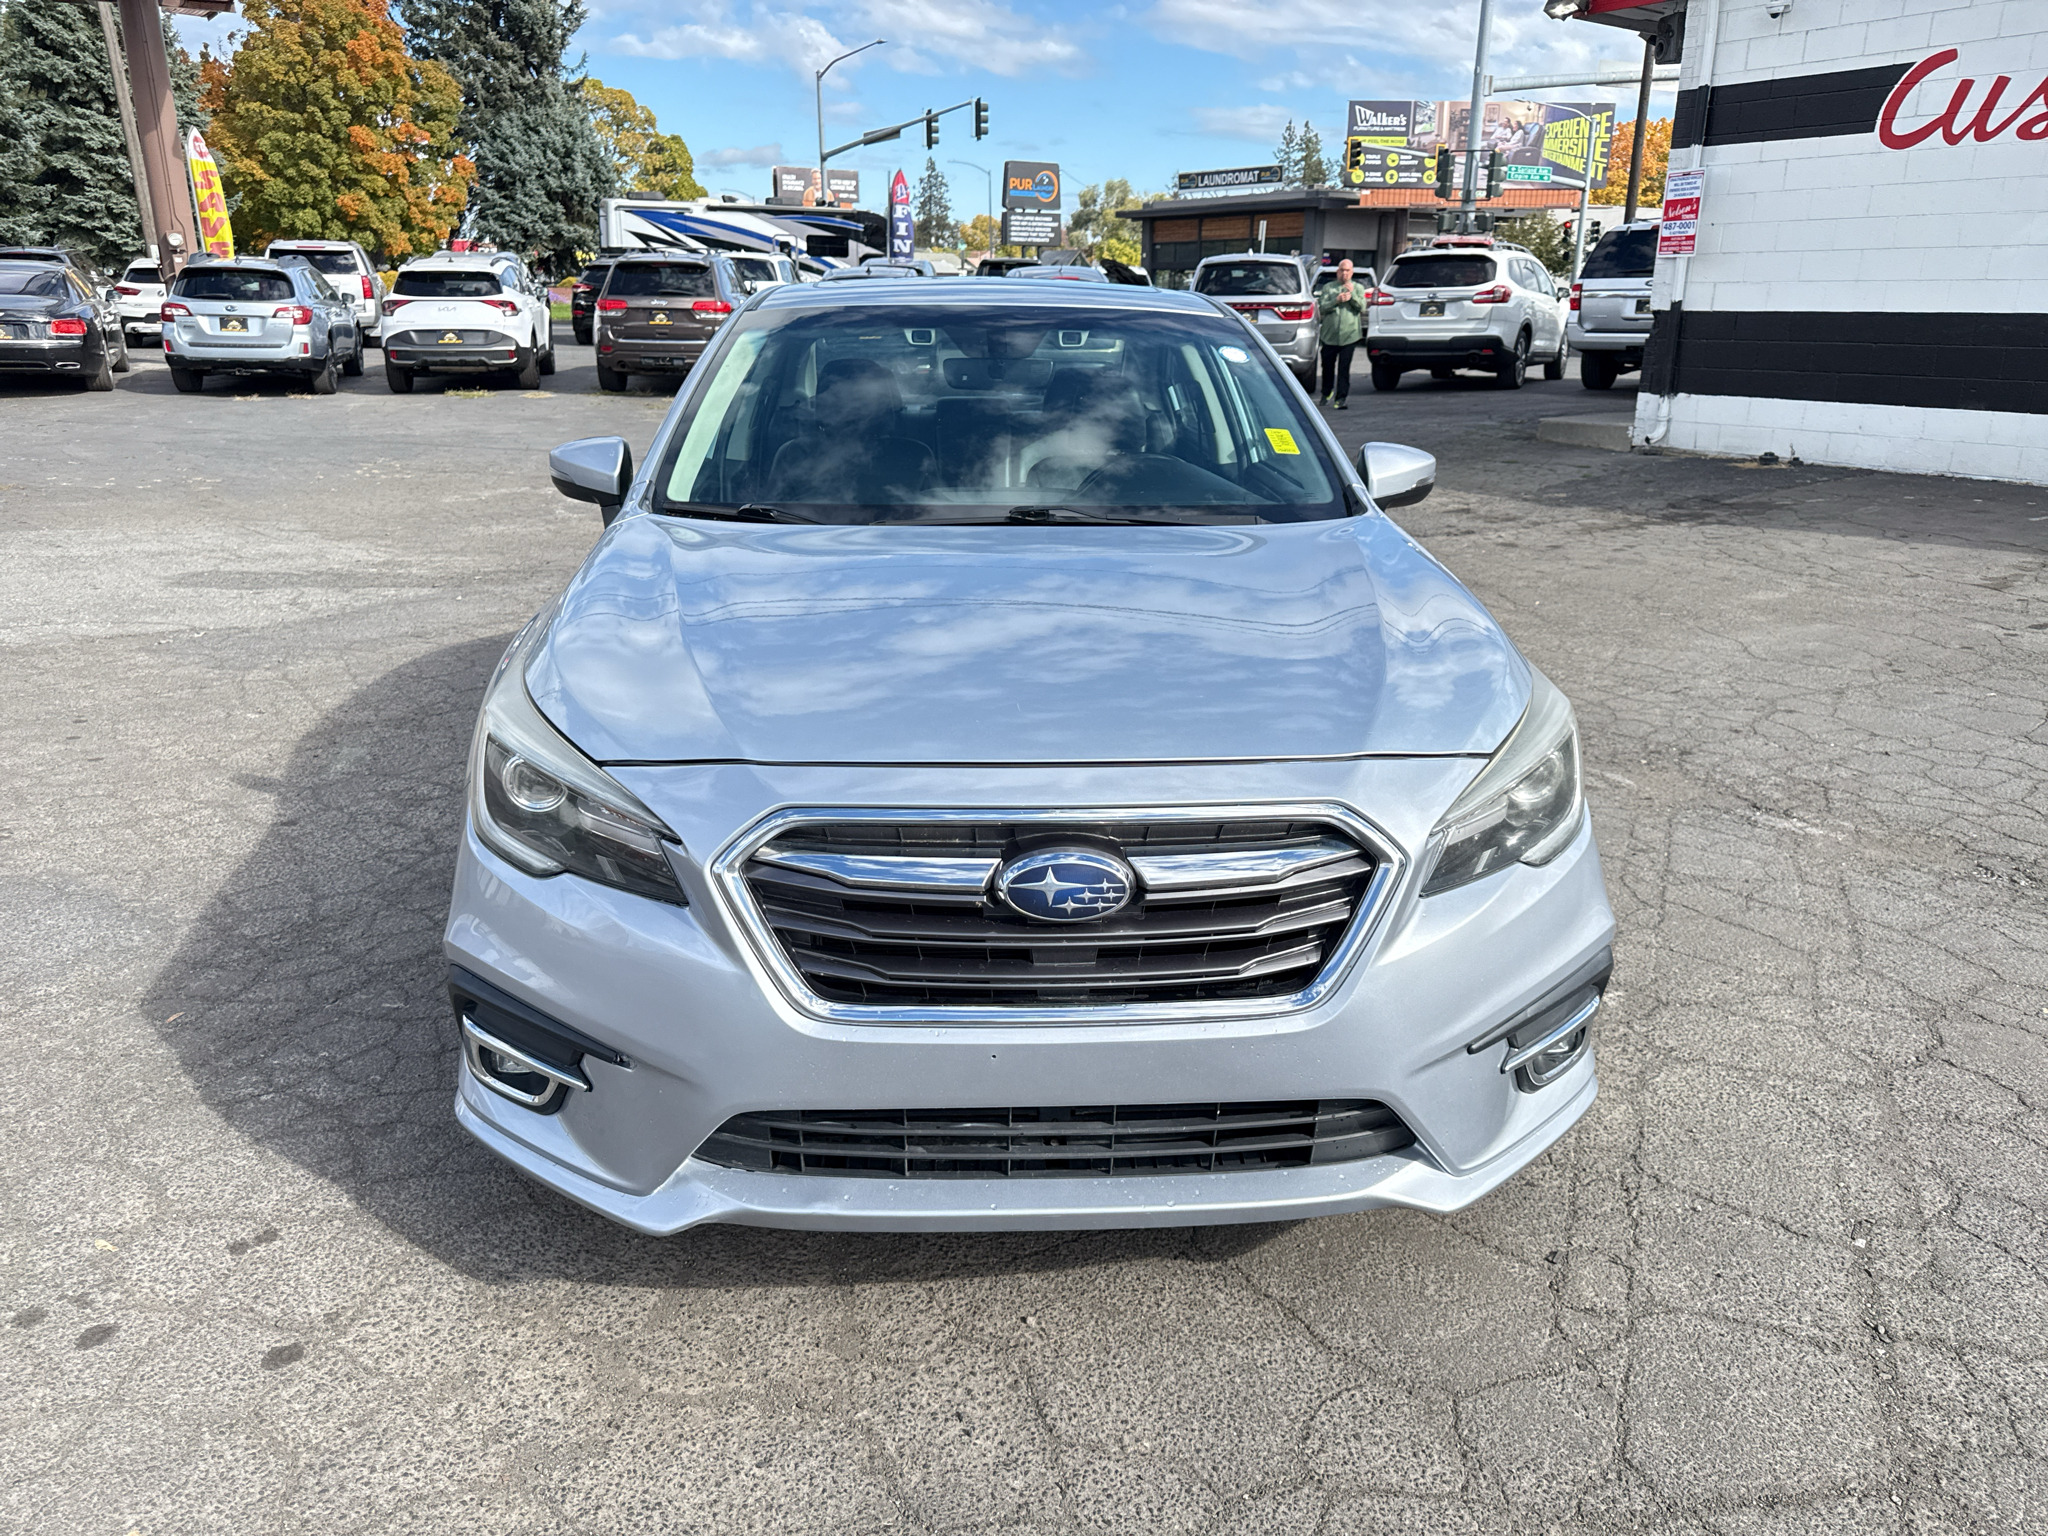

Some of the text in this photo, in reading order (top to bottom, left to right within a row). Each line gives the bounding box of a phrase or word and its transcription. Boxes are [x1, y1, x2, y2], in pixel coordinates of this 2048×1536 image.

[1009, 178, 1033, 190] PUR
[1198, 170, 1260, 186] LAUNDROMAT
[195, 170, 230, 258] SAVE
[893, 204, 912, 258] FIN
[1664, 221, 1695, 230] 487-0001
